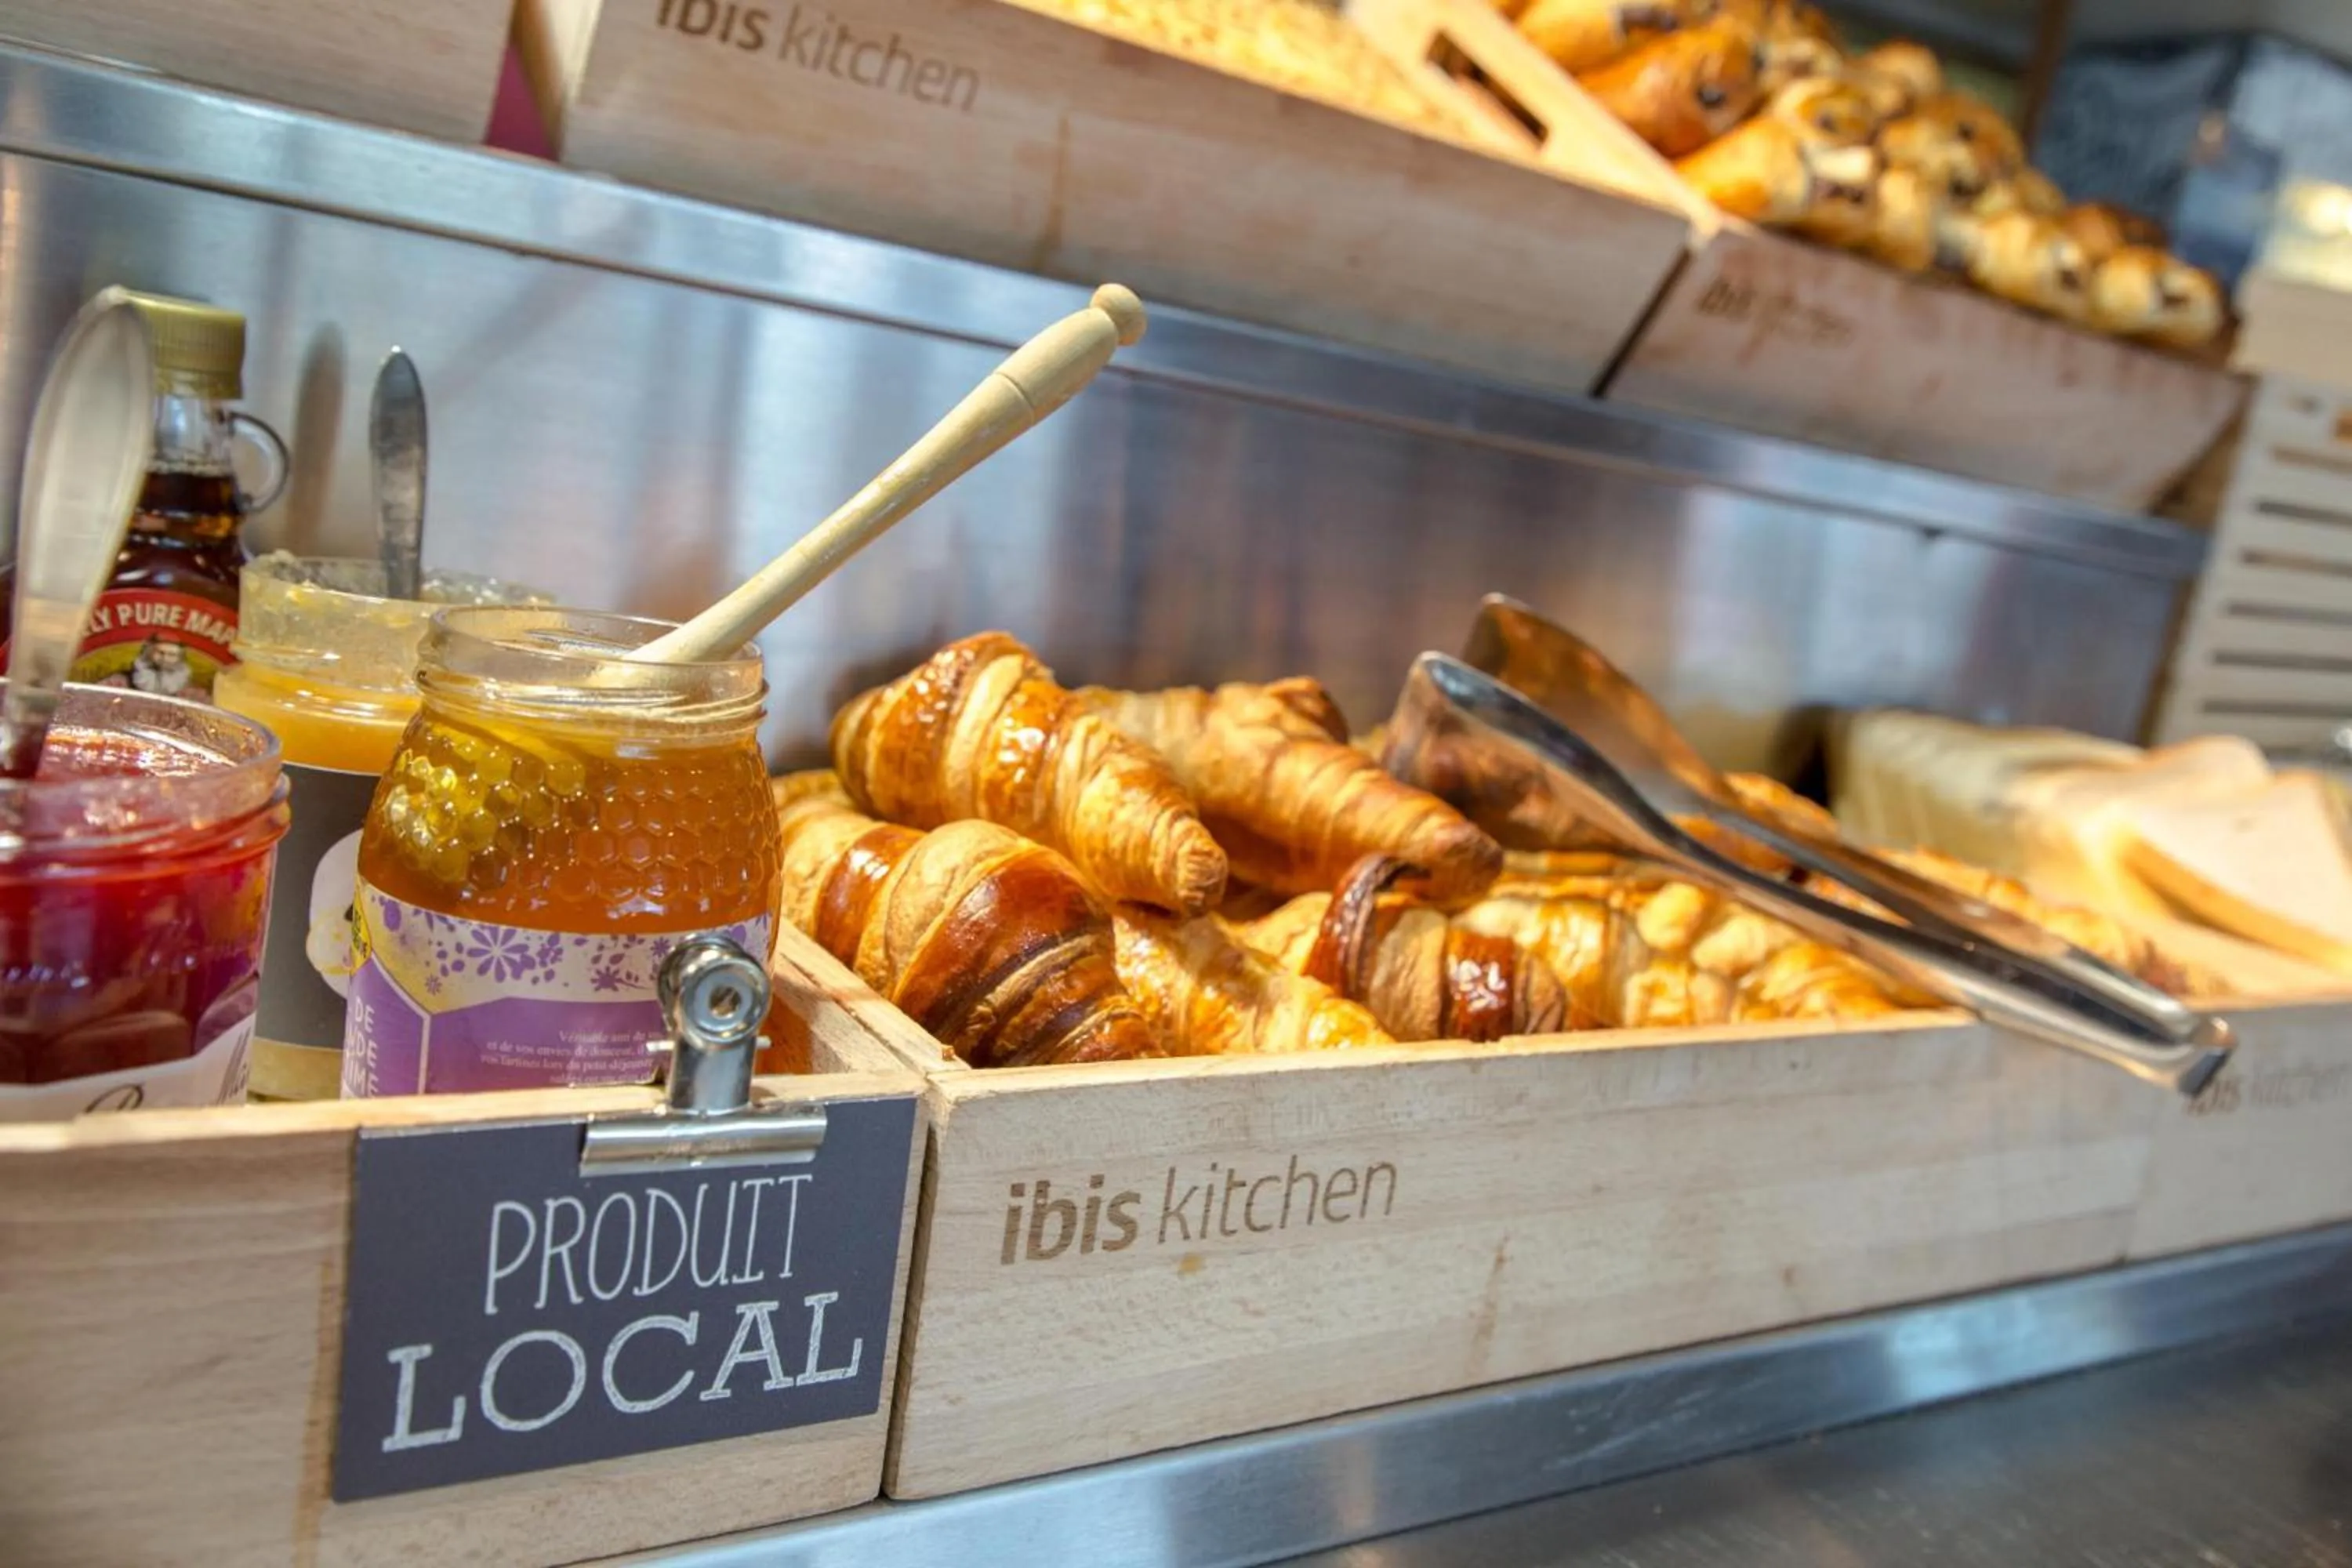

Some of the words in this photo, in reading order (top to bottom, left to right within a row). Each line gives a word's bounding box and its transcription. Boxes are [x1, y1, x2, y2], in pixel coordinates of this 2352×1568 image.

[775, 5, 981, 112] kitchen
[84, 604, 113, 635] LY
[115, 601, 185, 627] PURE
[183, 609, 238, 645] MAP
[499, 1039, 514, 1053] de
[574, 1044, 589, 1058] de
[484, 1174, 813, 1315] PRODUIT
[1000, 1174, 1142, 1265] ibis
[1157, 1153, 1398, 1244] kitchen
[382, 1291, 862, 1453] LOCAL
